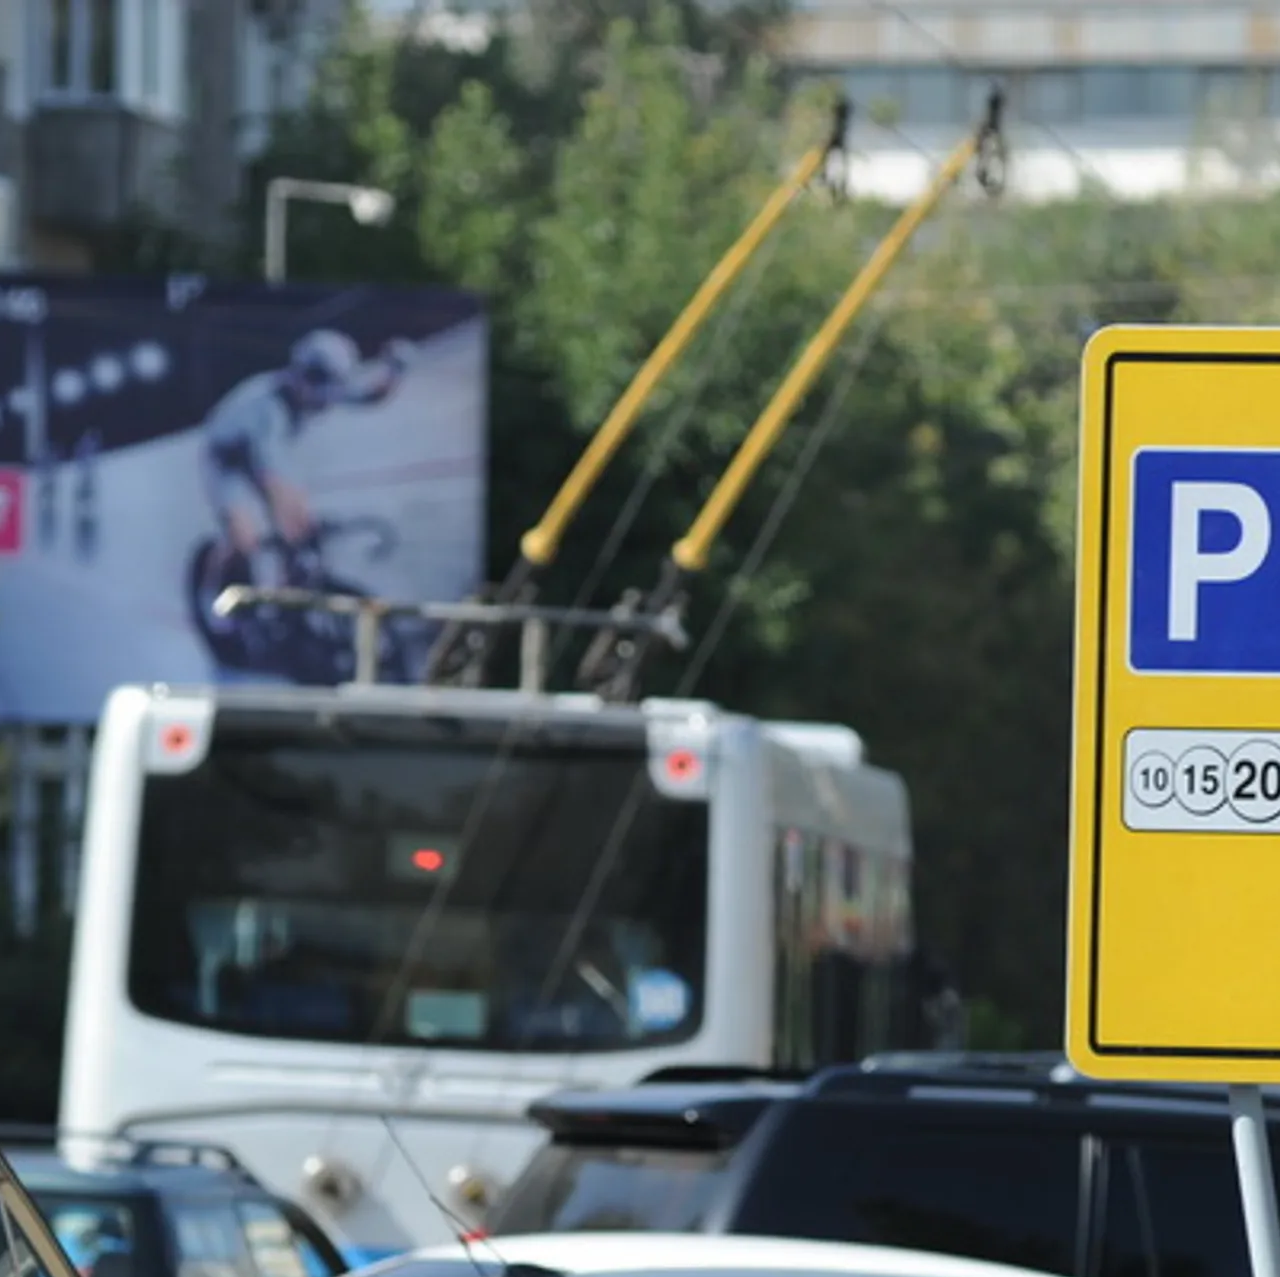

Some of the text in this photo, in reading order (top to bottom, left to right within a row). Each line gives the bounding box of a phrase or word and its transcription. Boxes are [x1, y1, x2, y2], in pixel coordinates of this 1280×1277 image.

[1168, 482, 1271, 642] P
[1141, 767, 1169, 791] 10
[1183, 764, 1220, 795] 15
